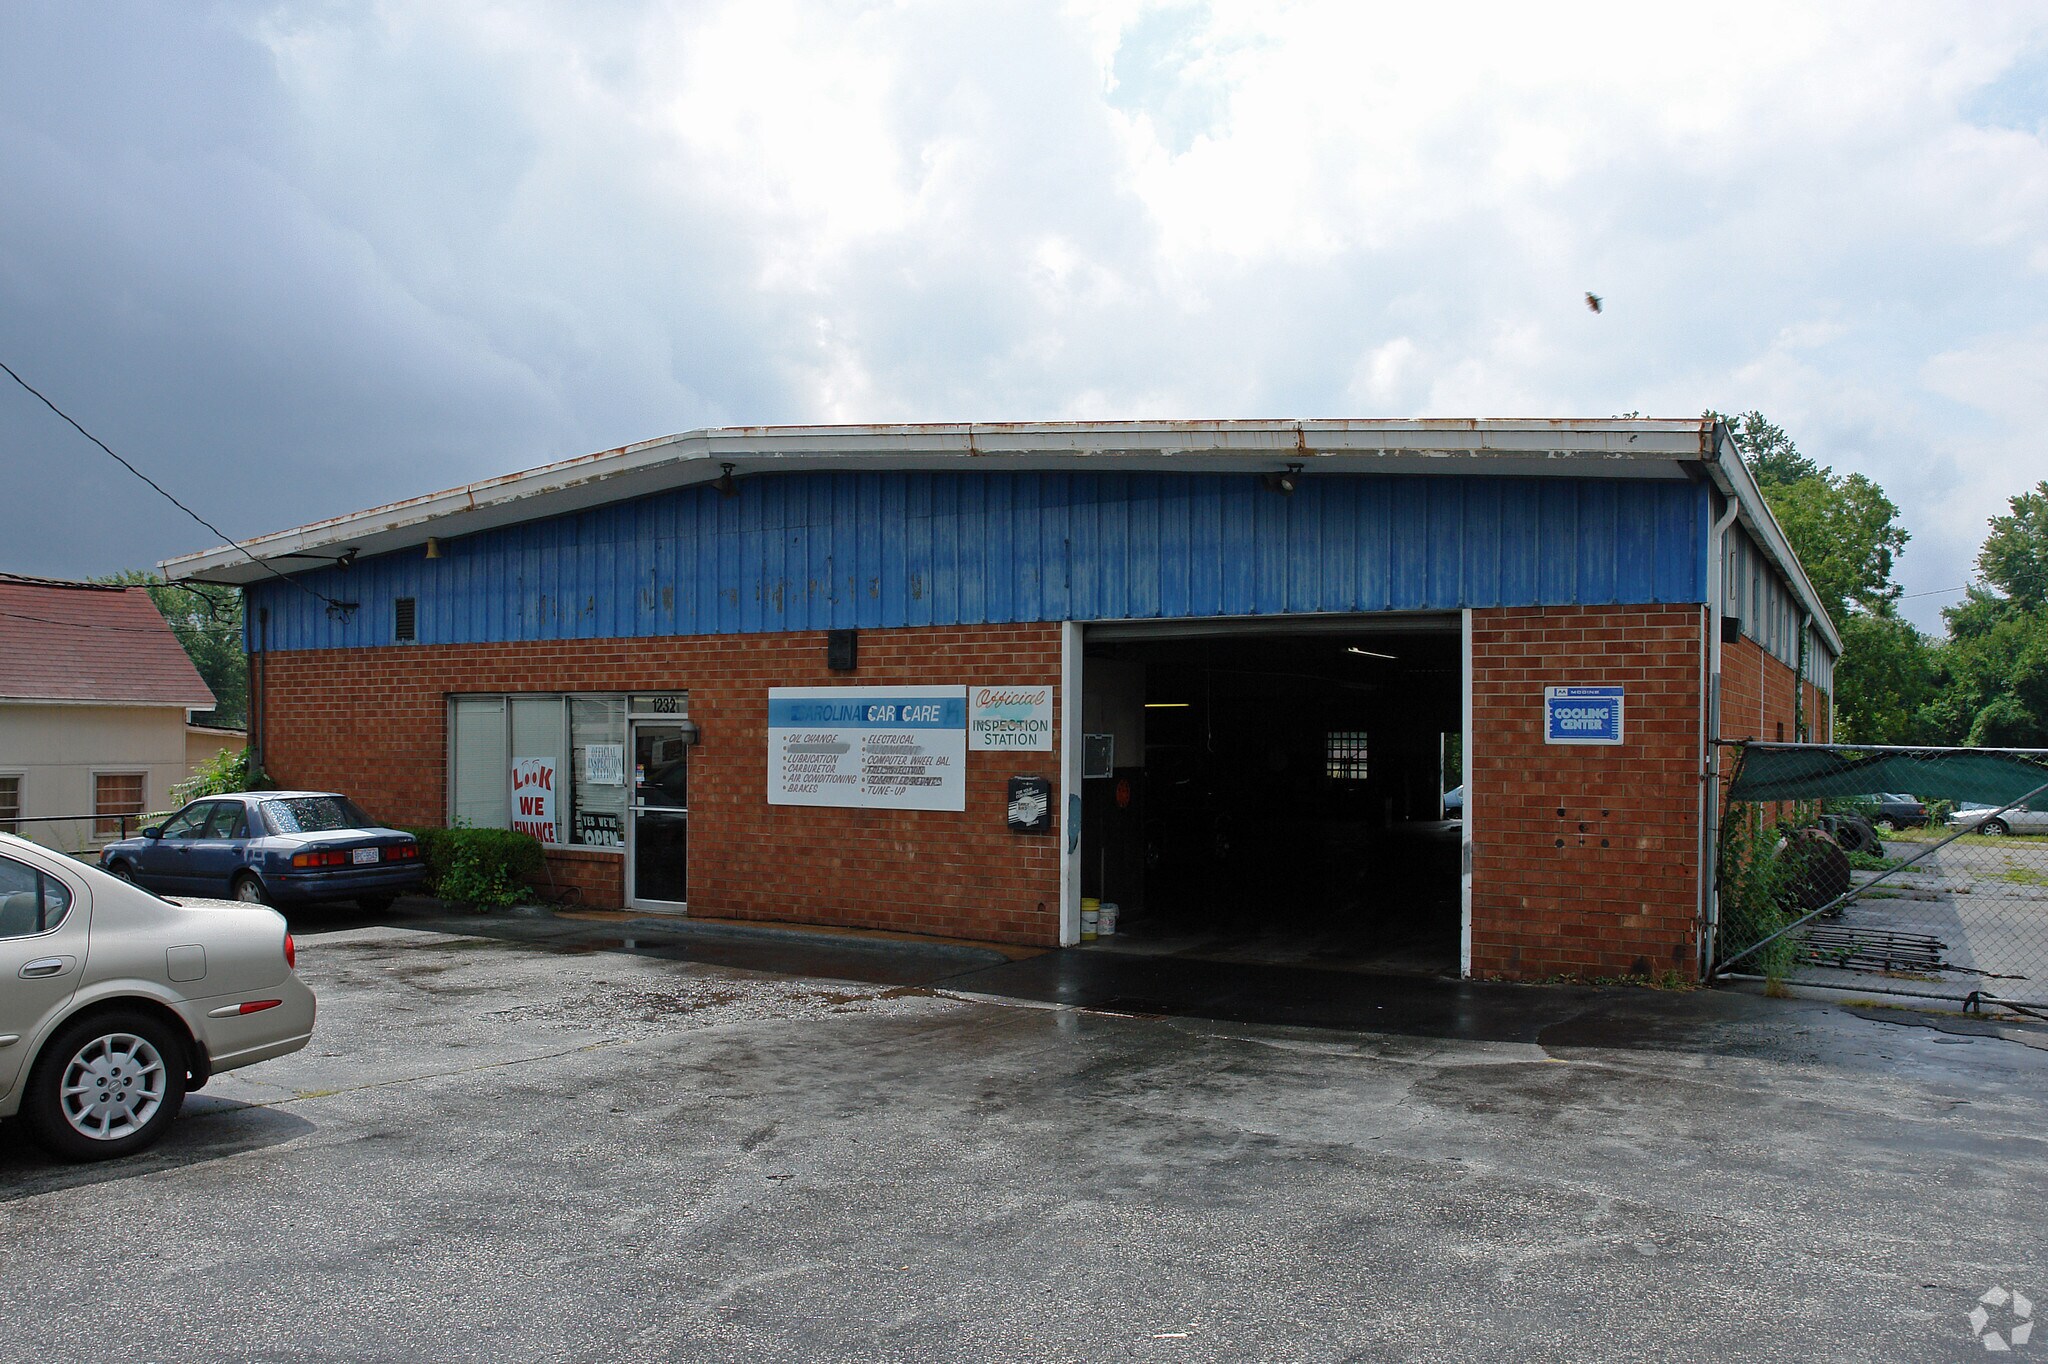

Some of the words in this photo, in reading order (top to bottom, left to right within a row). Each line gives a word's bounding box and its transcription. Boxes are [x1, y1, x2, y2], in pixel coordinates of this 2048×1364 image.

[976, 689, 1045, 708] Official
[652, 698, 676, 713] 1232
[867, 705, 896, 722] CAR
[902, 705, 941, 722] CARE
[1554, 707, 1609, 719] COOLING
[972, 719, 1048, 732] INSPECTION
[1560, 719, 1602, 730] CENTER
[788, 734, 802, 743] OIL
[803, 734, 838, 743] CHANGE
[868, 734, 914, 744] ELECTRICAL
[984, 733, 1037, 745] STATION
[588, 758, 621, 768] INSPECTION
[787, 754, 839, 763] LUBRICATION
[867, 755, 907, 765] COMPUTER
[910, 756, 934, 766] WHEEL
[787, 764, 836, 773] CARBURETOR
[787, 773, 801, 782] AIR
[802, 773, 857, 784] CONDITIONING
[787, 784, 819, 793] BRAKES
[867, 785, 907, 795] TUNE-UP
[519, 796, 545, 816] WE
[583, 816, 595, 826] YES
[598, 817, 617, 828] WE'RE
[514, 821, 555, 843] FINANCE
[585, 829, 619, 846] OPEN
